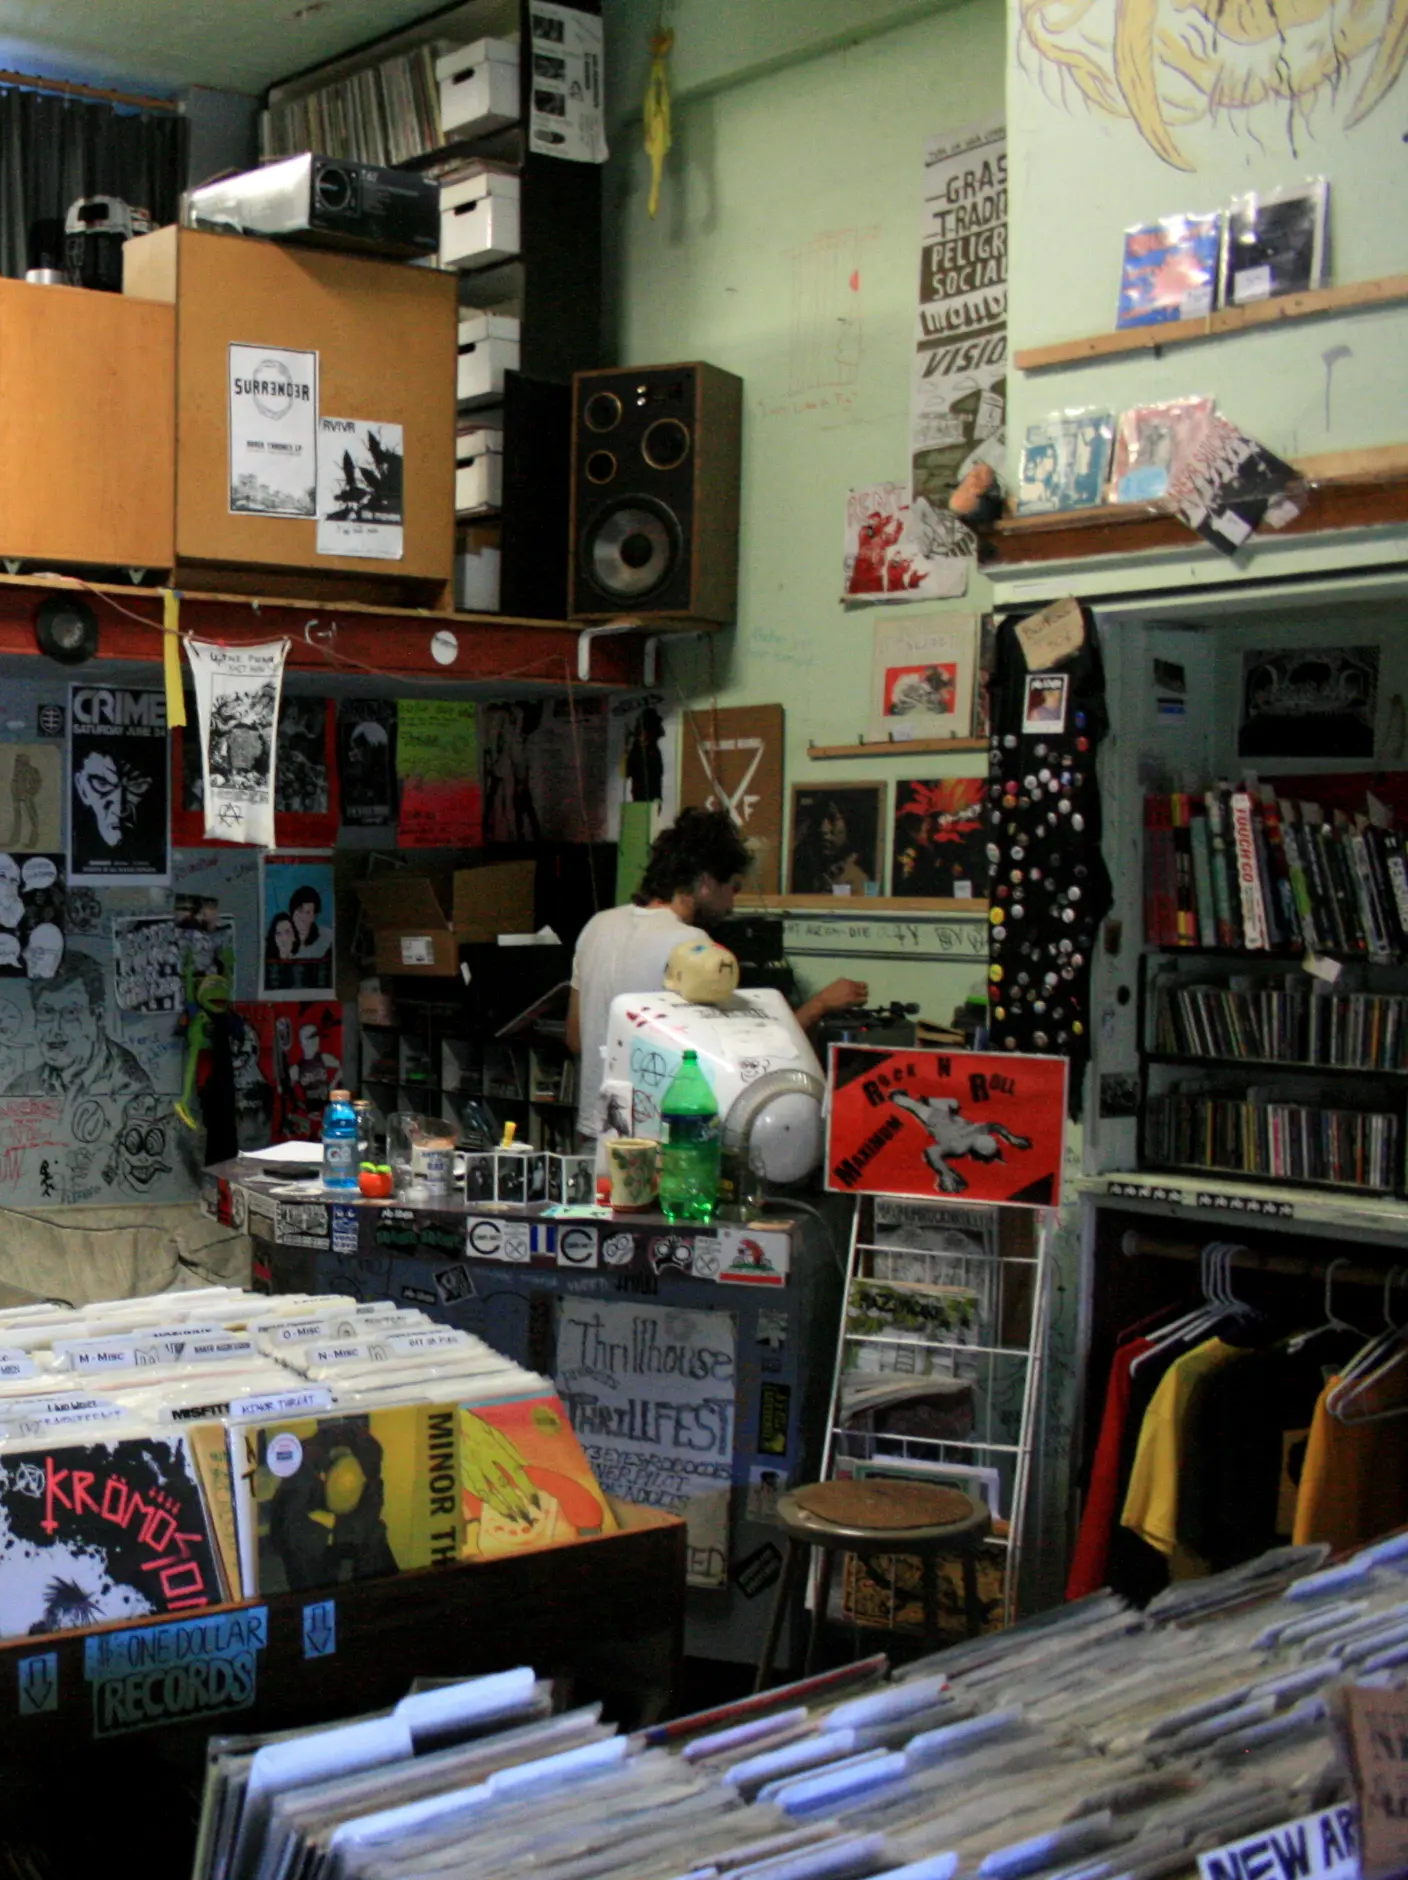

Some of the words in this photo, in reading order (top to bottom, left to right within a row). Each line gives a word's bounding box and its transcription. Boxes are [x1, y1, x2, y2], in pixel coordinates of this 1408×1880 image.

[73, 689, 166, 726] CRIME
[428, 1412, 456, 1517] MINOR
[174, 1616, 265, 1659] DOLLAR
[99, 1652, 253, 1728] RECORDS
